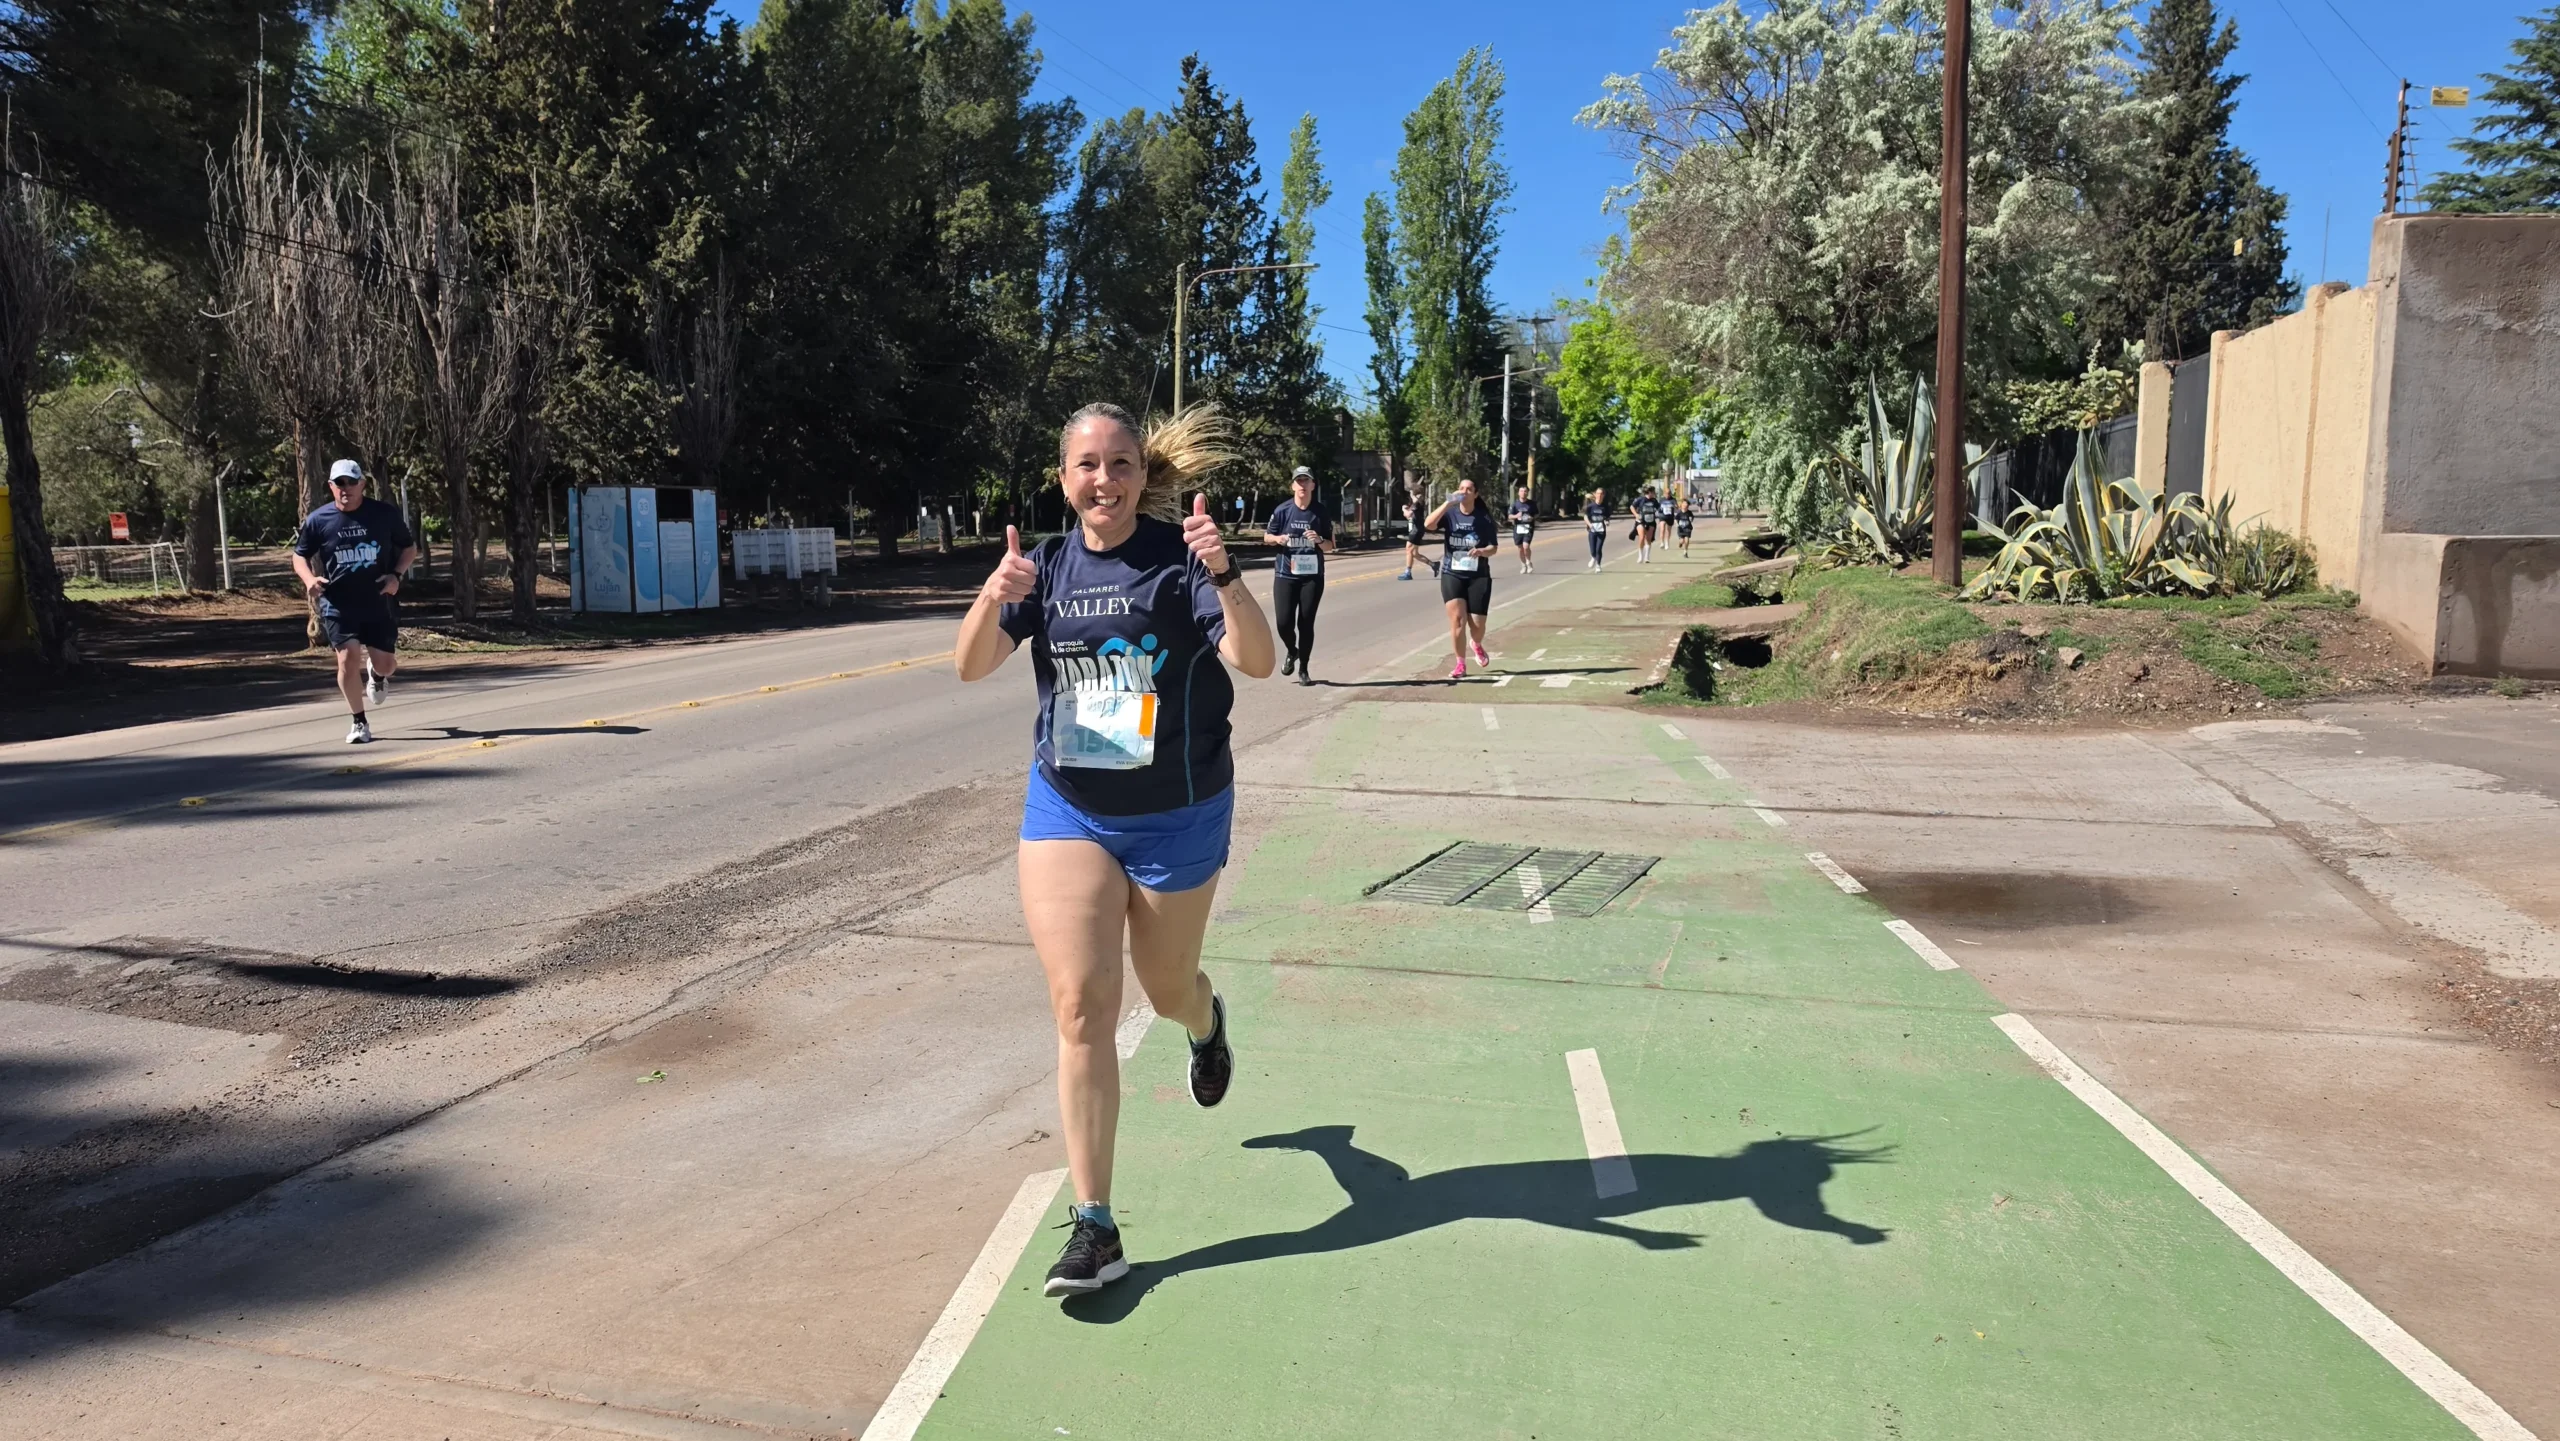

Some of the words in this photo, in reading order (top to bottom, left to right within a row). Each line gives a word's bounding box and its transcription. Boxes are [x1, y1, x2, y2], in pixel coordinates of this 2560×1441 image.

[337, 528, 368, 538] VALLEY
[594, 581, 621, 595] Luján
[1072, 585, 1120, 595] PALMARES
[1055, 597, 1135, 618] VALLEY
[1056, 639, 1084, 648] parroquia
[1074, 728, 1126, 755] 154
